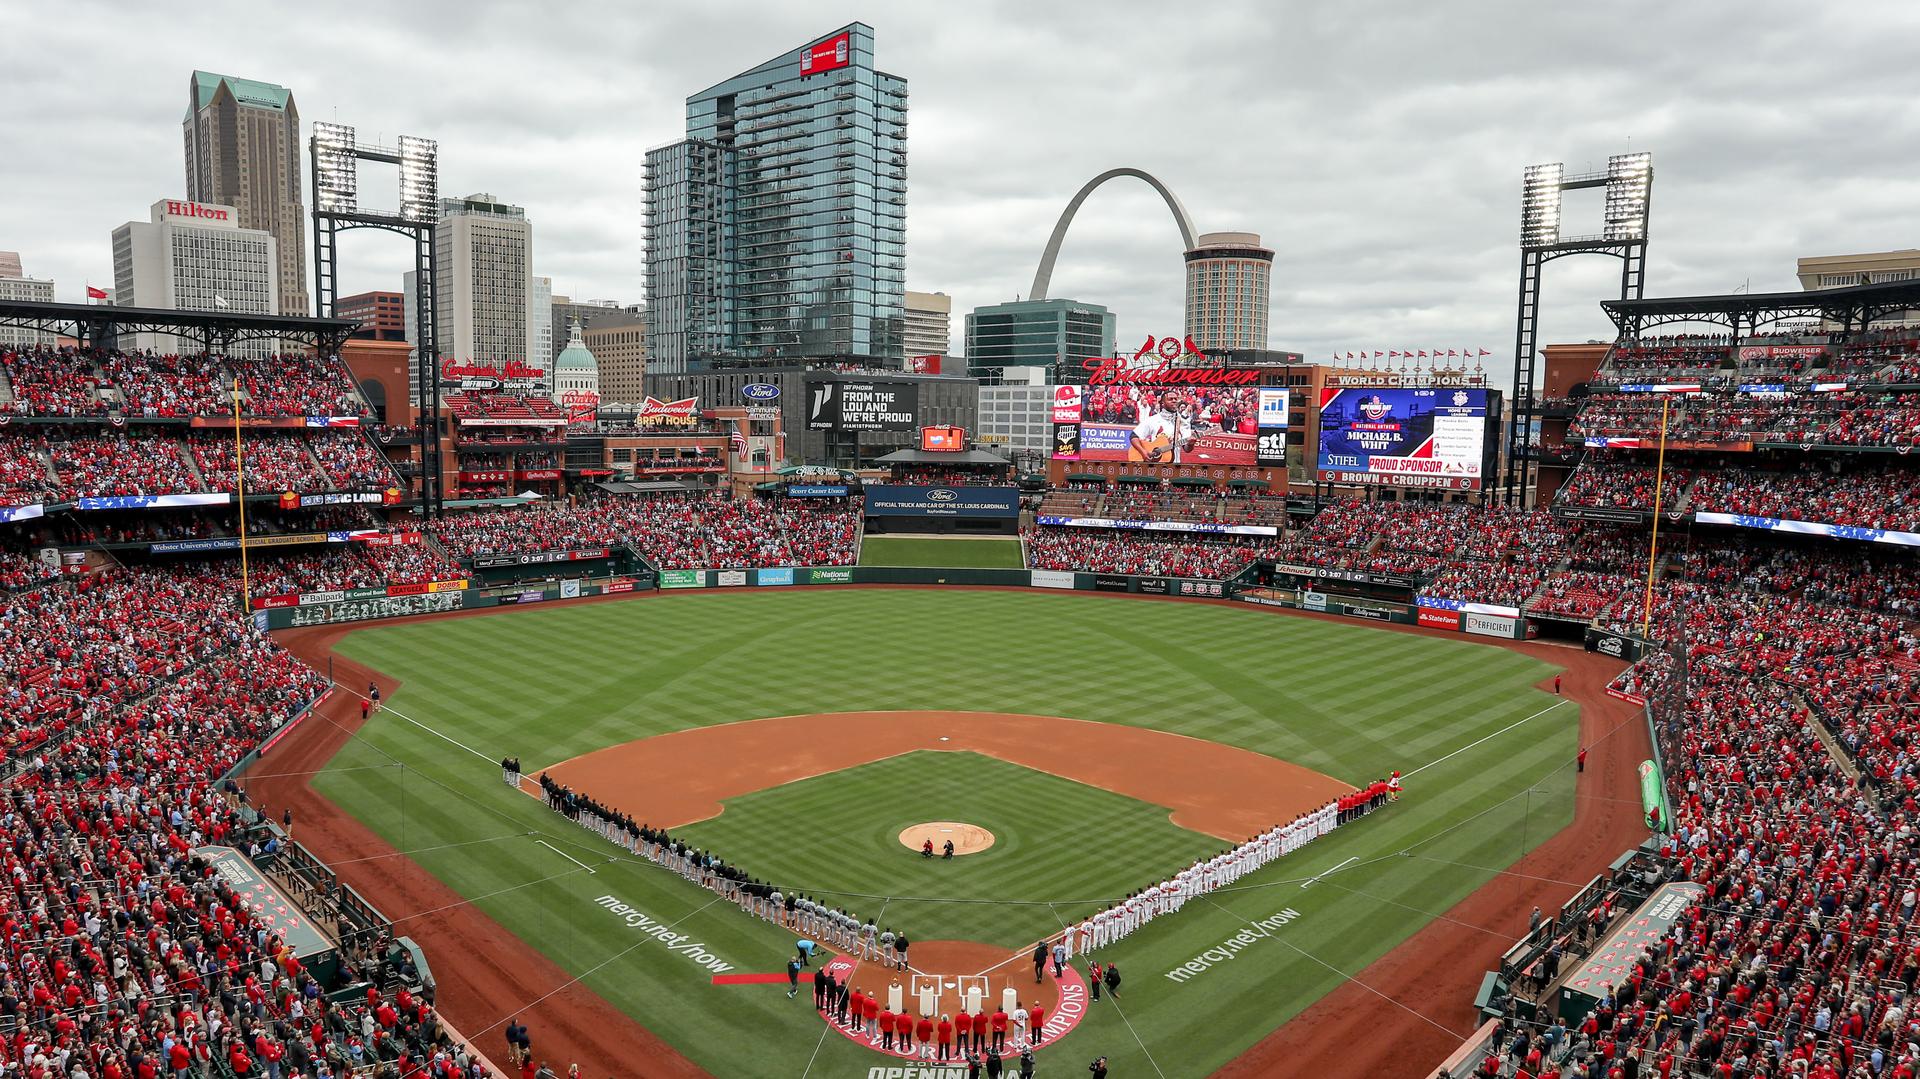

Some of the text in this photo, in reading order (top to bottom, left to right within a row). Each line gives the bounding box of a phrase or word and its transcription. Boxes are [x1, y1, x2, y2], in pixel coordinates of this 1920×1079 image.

[167, 201, 228, 220] Hilton
[498, 360, 544, 380] Nation
[1082, 357, 1261, 385] Budweiser
[1338, 375, 1470, 386] WORLD CHAMPIONS
[750, 385, 773, 397] Ford
[842, 392, 895, 402] FROM THE
[637, 402, 698, 415] Budweiser
[745, 407, 780, 415] Community
[842, 403, 887, 412] LOU AND
[637, 416, 697, 425] BREW HOUSE
[842, 412, 912, 423] WE'RE PROUD
[1099, 429, 1115, 437] WIN
[1347, 432, 1403, 441] MICHAEL B.
[1215, 440, 1257, 452] STADIUM
[1259, 433, 1286, 449] stl
[1361, 441, 1389, 450] WHIT
[1327, 454, 1360, 467] STIFEL
[1087, 465, 1093, 474] 2
[1108, 466, 1114, 474] 9
[1368, 459, 1443, 473] PROUD SPONSOR
[1196, 469, 1207, 478] 24
[1213, 470, 1225, 479] 42
[1230, 471, 1242, 479] 45
[1341, 473, 1451, 487] BROWN & CROUPPEN
[353, 493, 382, 503] LAND
[931, 490, 952, 499] Ford
[1116, 520, 1130, 528] YOU
[152, 540, 235, 551] Webster University Online
[1278, 567, 1314, 576] Schnucks
[390, 584, 425, 594] SEATGEEK
[436, 581, 461, 589] DOBBS
[309, 592, 344, 603] Ballpark
[353, 588, 387, 598] Central Bank
[1467, 618, 1512, 632] PERFICIENT
[594, 895, 734, 973] mercy.net/now
[1164, 907, 1301, 983] mercy.net/now
[868, 1067, 969, 1079] OPENIN
